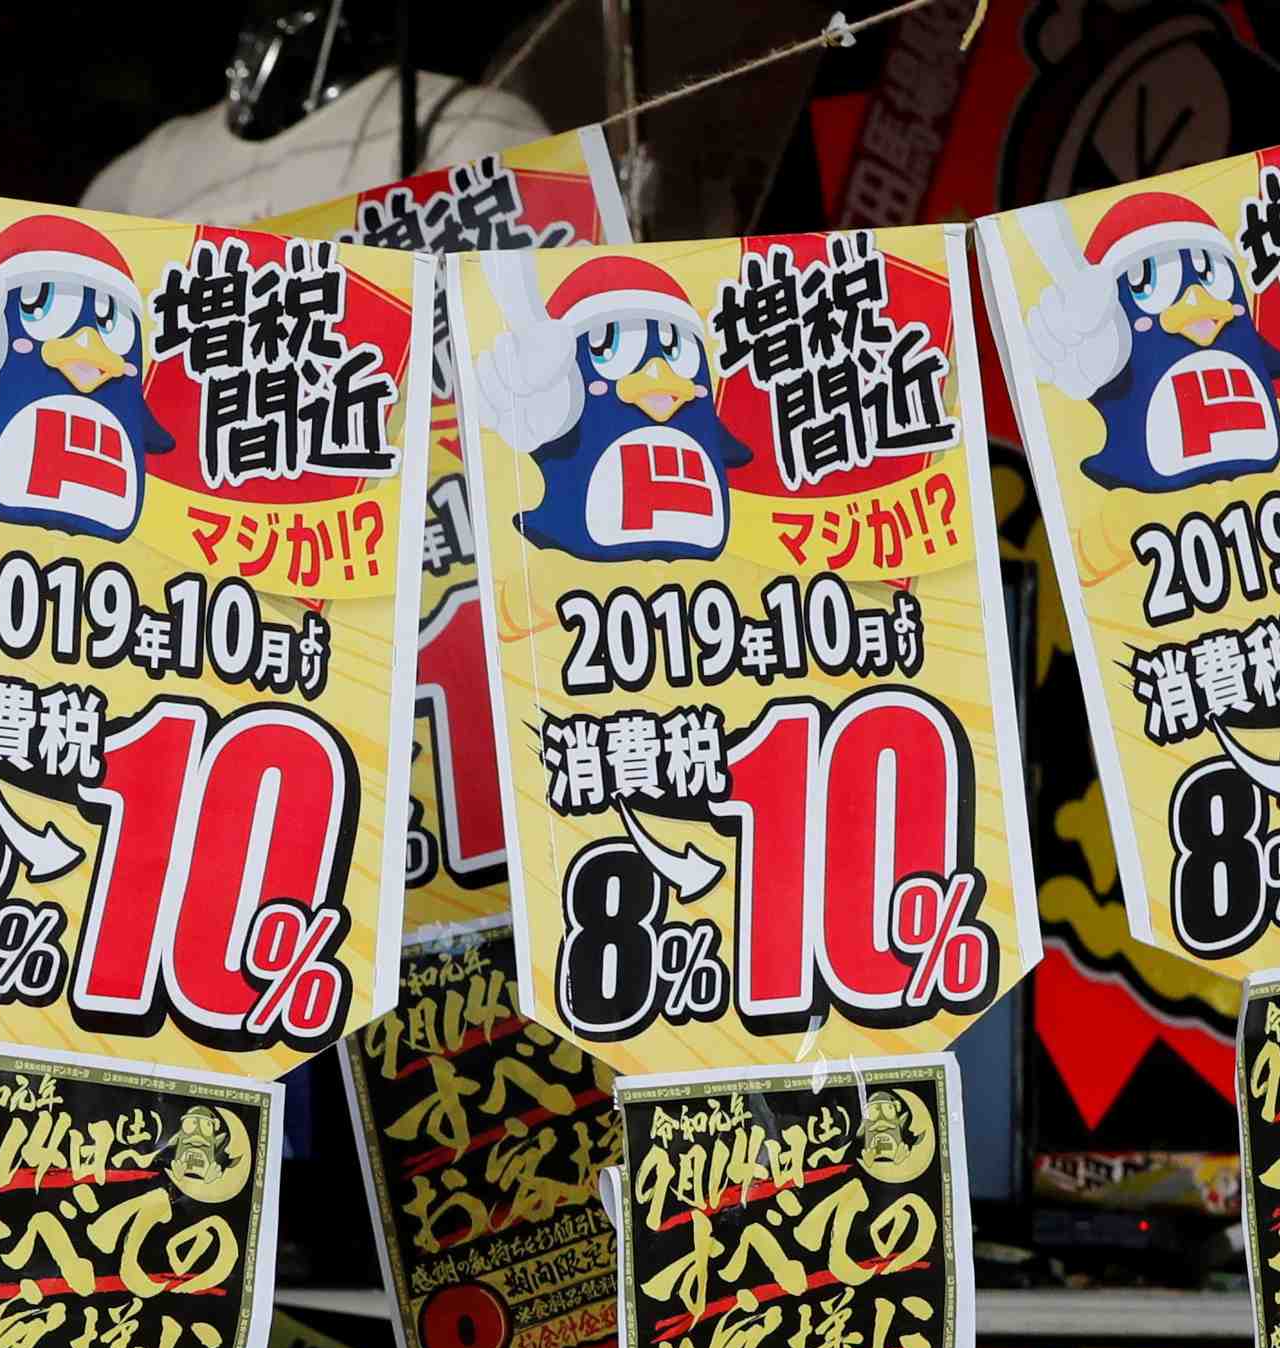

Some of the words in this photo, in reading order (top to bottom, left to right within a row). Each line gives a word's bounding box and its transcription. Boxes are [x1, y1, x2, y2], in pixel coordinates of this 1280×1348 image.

[204, 353, 397, 480] 間近
[778, 334, 957, 484] 間近
[545, 709, 726, 808] 消費税
[73, 703, 345, 1038] 10%
[711, 692, 992, 1018] 10%
[561, 843, 722, 1032] 8%
[650, 1093, 753, 1147] 令和元年
[641, 1180, 938, 1326] すべての
